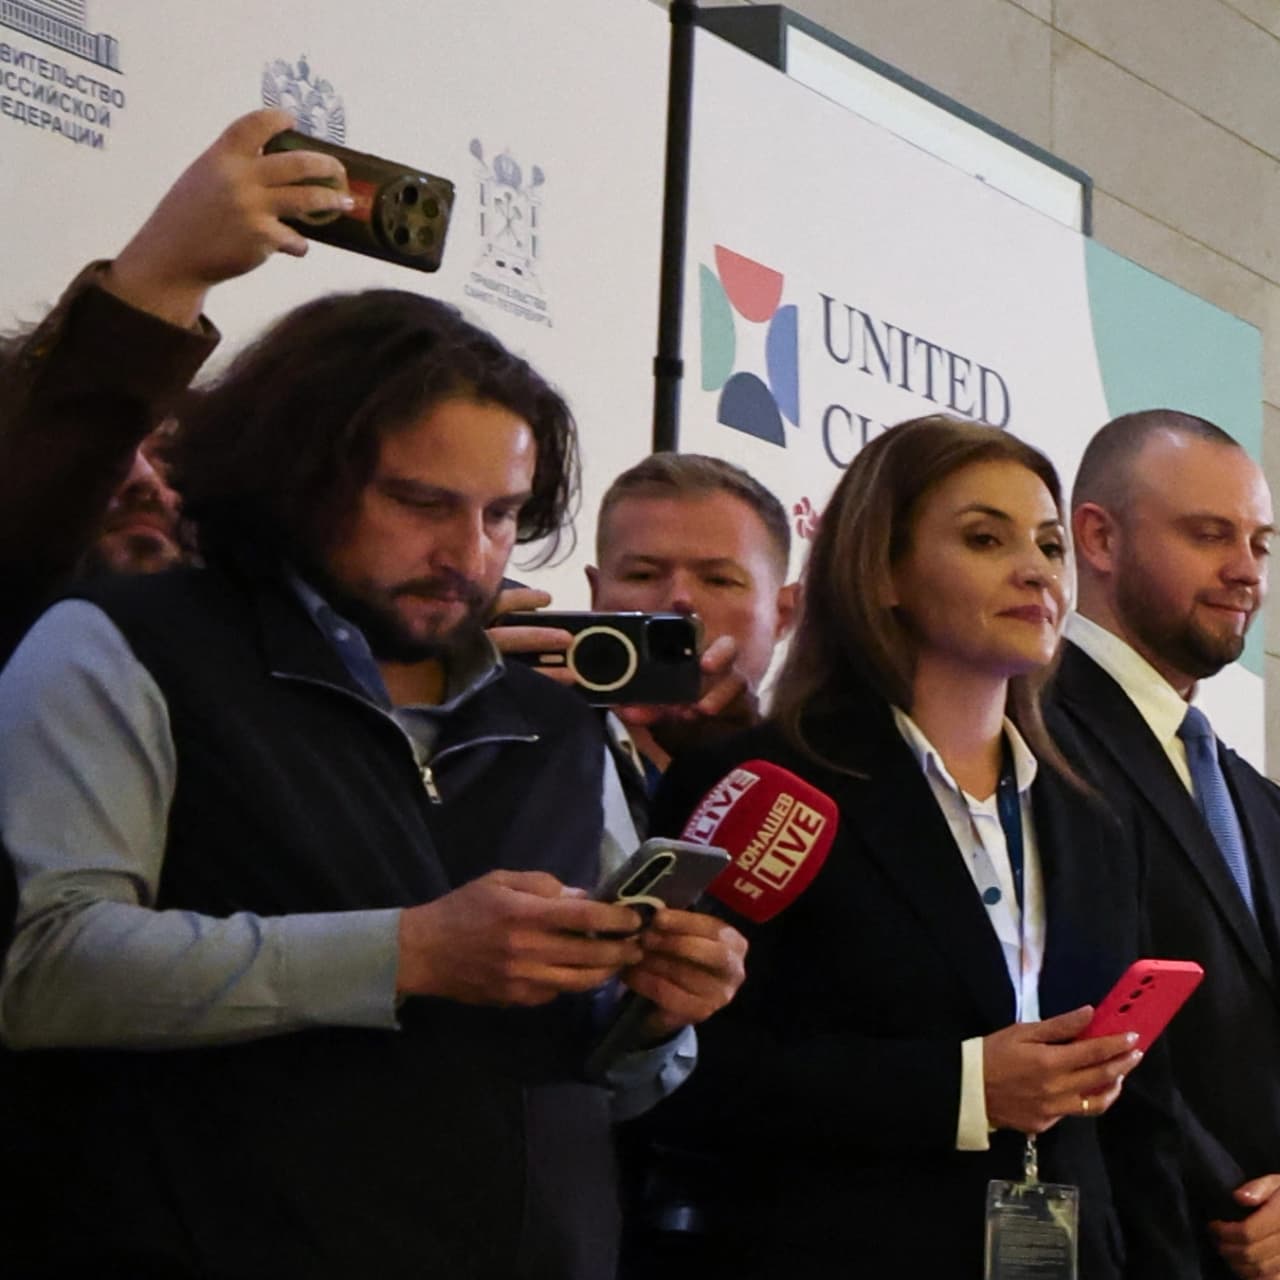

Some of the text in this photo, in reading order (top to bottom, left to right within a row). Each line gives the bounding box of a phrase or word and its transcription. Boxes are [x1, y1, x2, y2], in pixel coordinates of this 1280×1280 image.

[0, 69, 111, 128] ССИЙСКОЙ
[818, 292, 1011, 429] UNITED
[695, 770, 754, 840] LIVE
[736, 793, 795, 871] ЮНАШЕВ
[755, 804, 824, 887] LIVE
